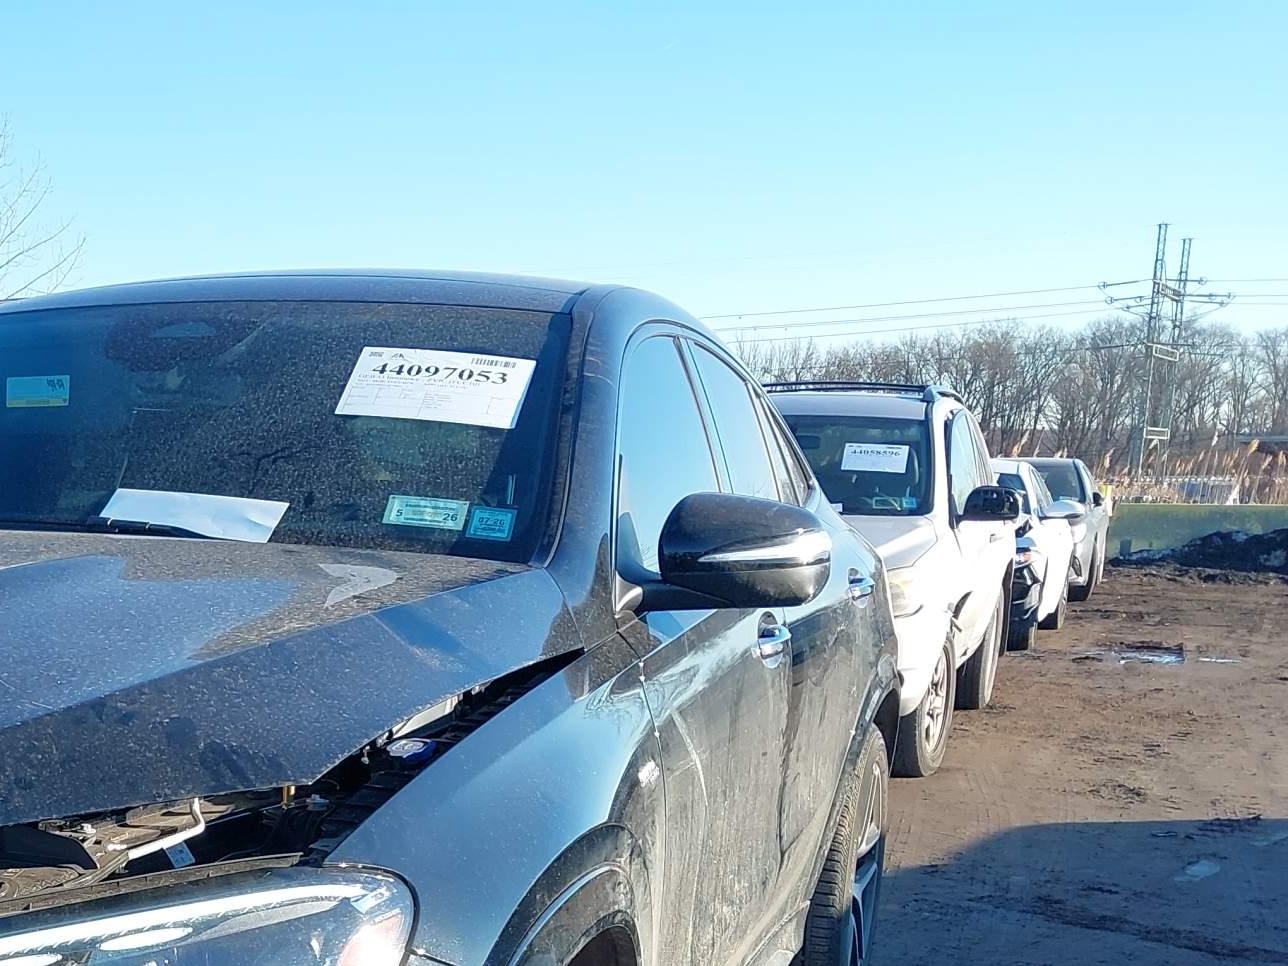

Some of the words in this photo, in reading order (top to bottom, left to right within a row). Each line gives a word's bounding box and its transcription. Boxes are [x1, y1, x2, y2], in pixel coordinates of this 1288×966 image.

[372, 362, 510, 385] 44097053
[850, 449, 901, 457] 44058596
[442, 513, 458, 522] 26
